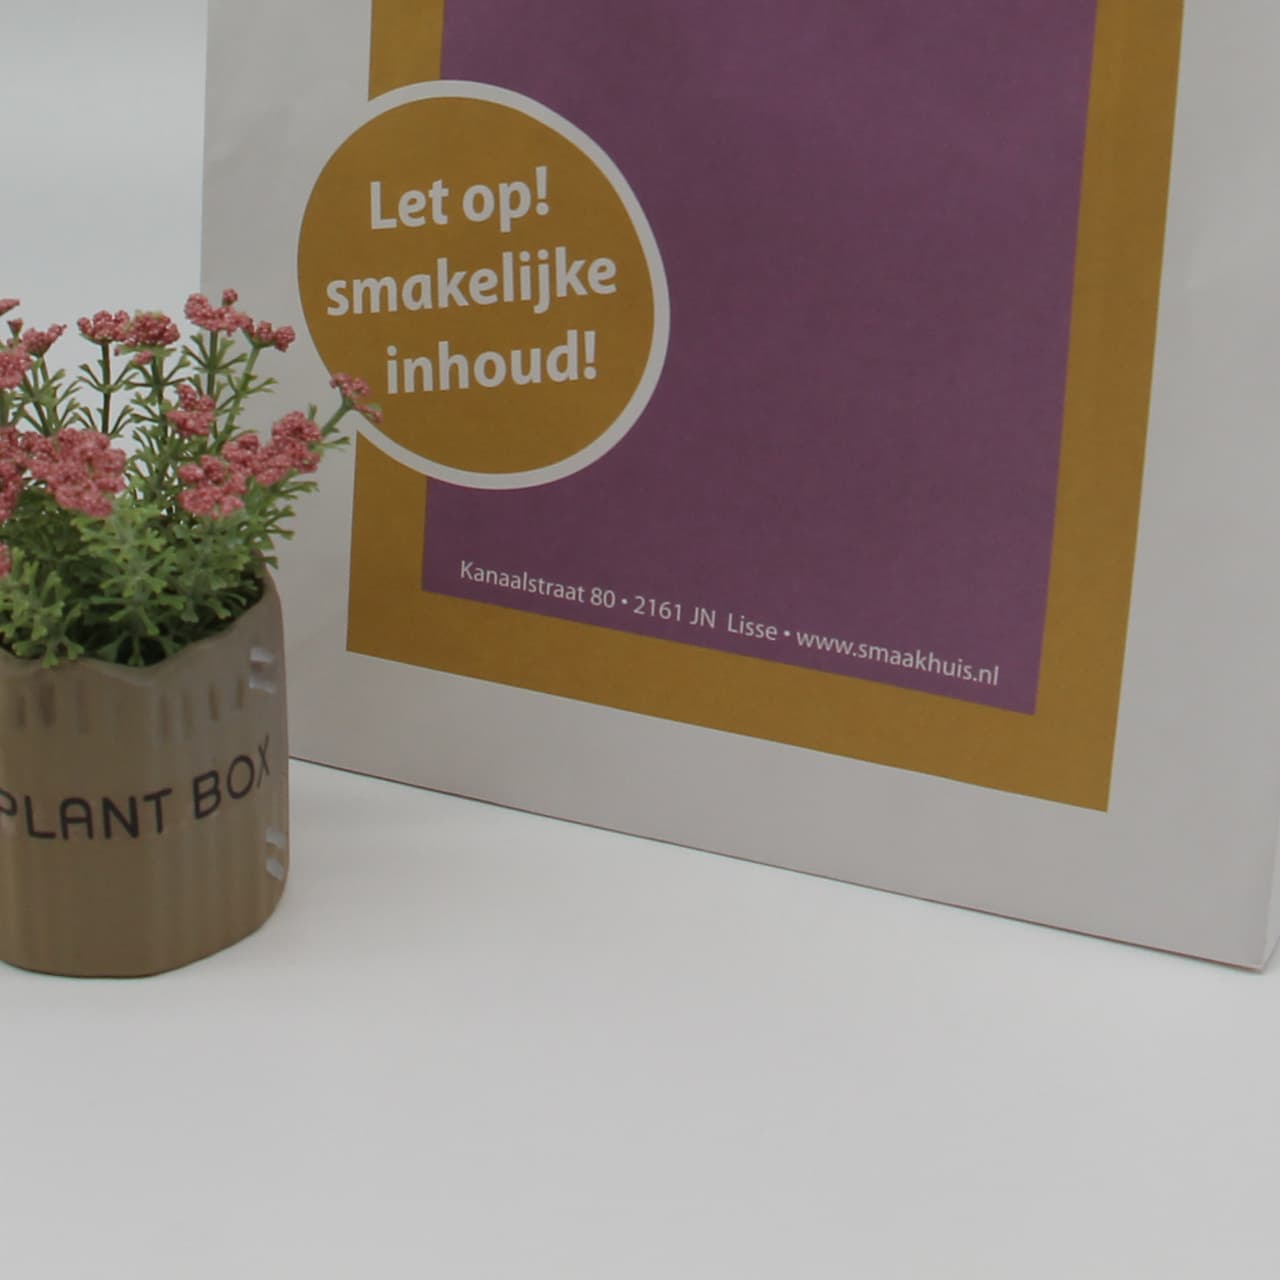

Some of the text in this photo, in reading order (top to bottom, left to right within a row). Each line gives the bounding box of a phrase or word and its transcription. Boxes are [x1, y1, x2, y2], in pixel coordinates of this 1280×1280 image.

[369, 166, 550, 233] Let op!
[326, 246, 617, 316] smakelijke
[386, 329, 597, 394] inhoud!
[460, 560, 1000, 686] Kanaalstraat 80 2161 JN Lisse www.smaakhuis.nl
[192, 735, 271, 820] BOX
